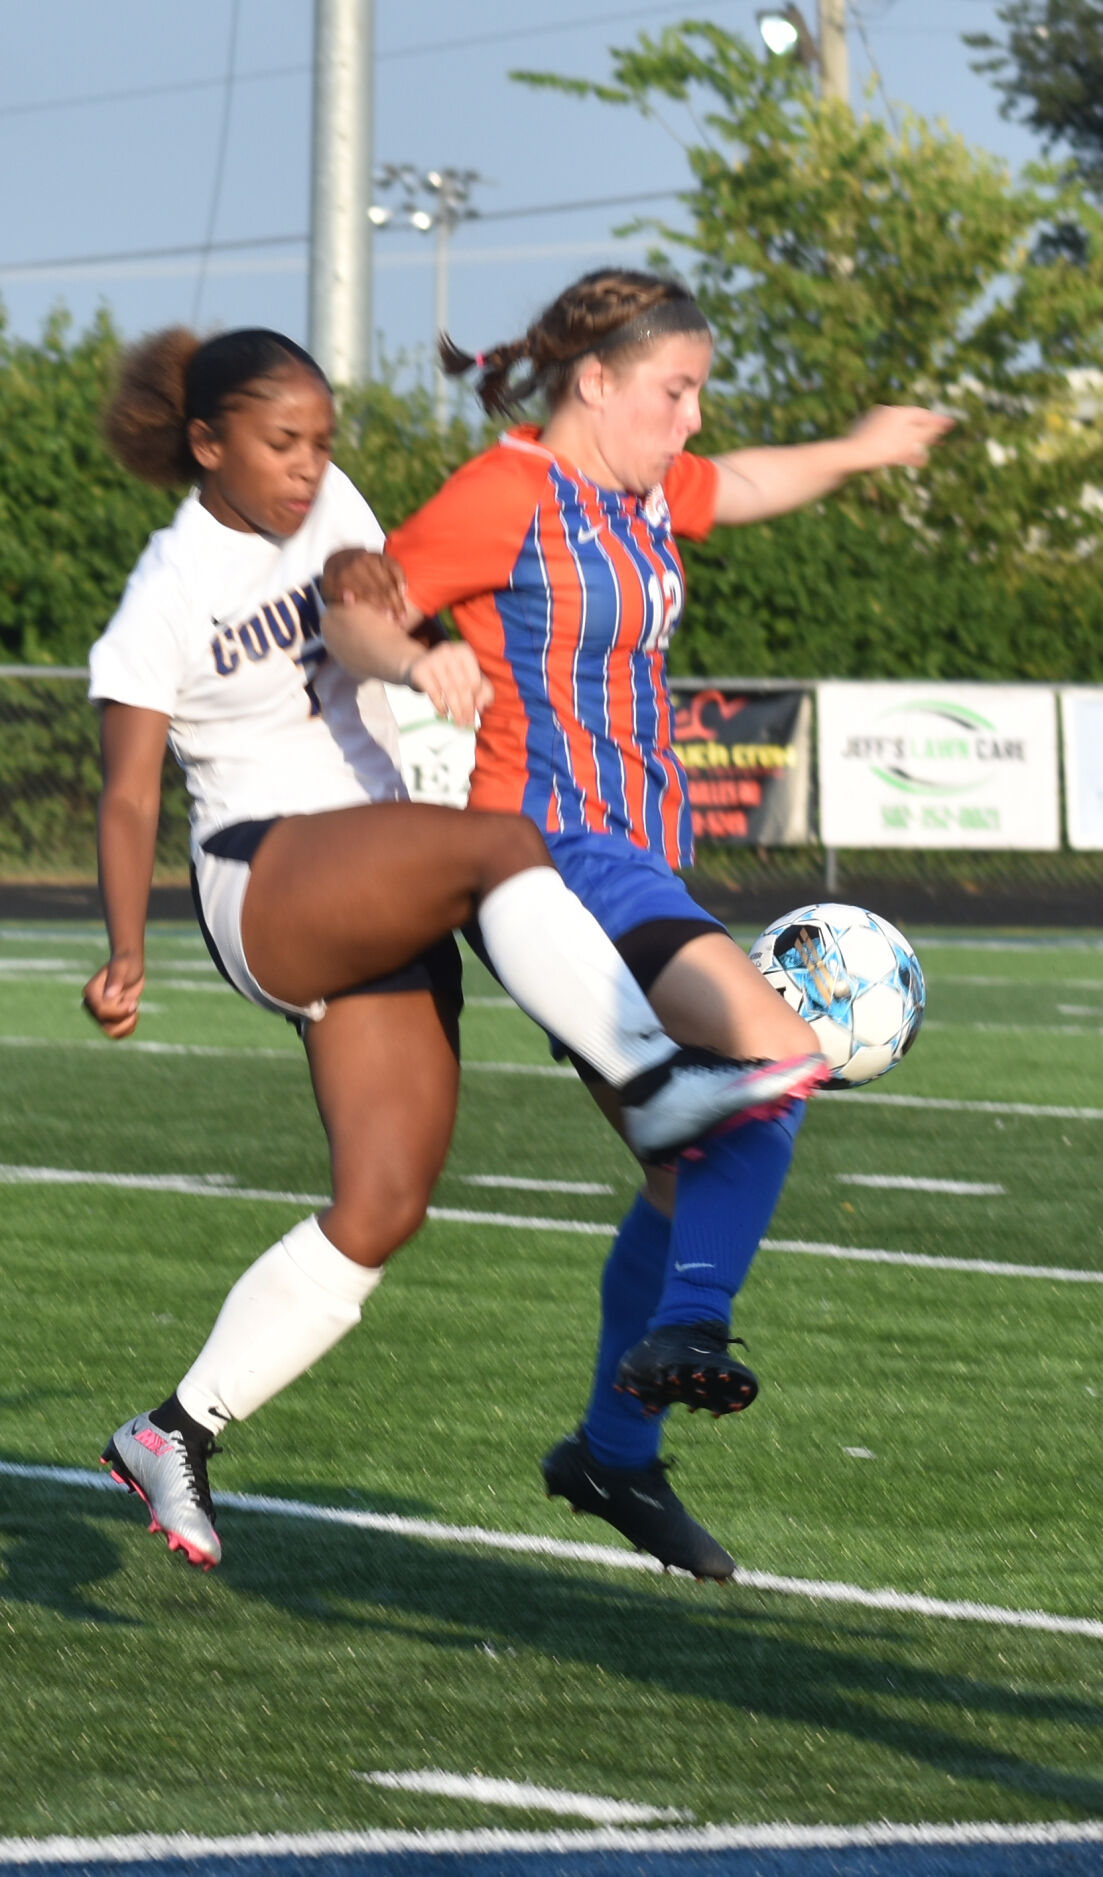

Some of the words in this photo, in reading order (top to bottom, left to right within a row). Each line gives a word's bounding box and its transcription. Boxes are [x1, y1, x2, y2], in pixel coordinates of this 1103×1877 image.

[208, 574, 325, 677] COUN
[644, 569, 683, 650] 12
[841, 736, 905, 761] JEFF'S
[911, 736, 971, 760] LAWN
[974, 736, 1028, 763] CARE
